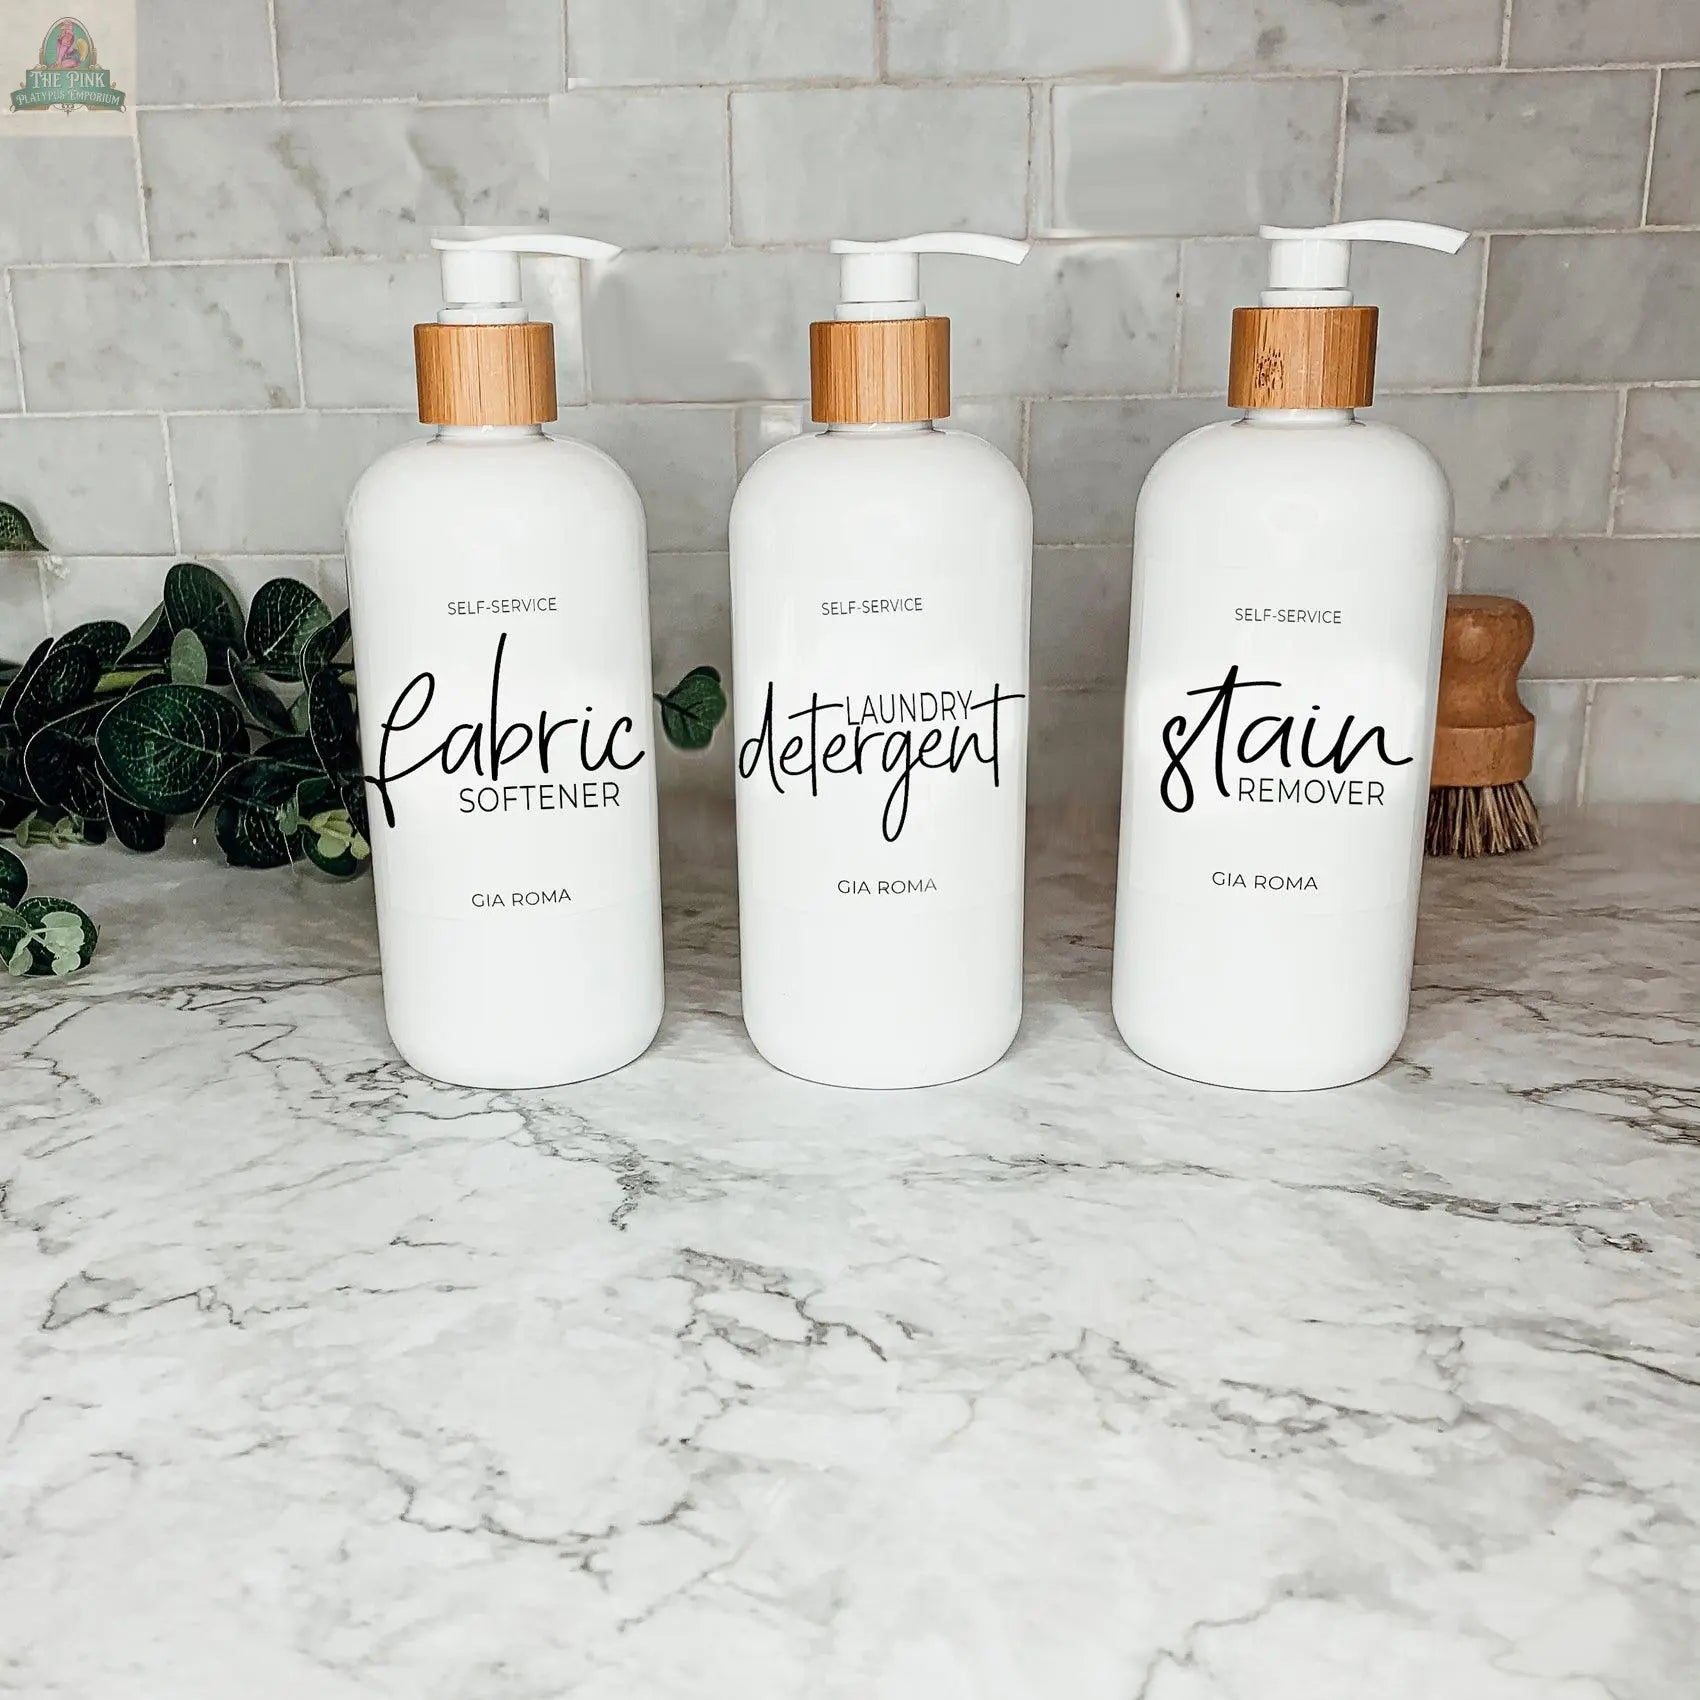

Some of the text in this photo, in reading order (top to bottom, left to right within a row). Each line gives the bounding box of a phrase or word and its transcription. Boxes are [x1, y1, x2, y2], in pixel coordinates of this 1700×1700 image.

[447, 597, 557, 615] SELF-SERVICE
[821, 597, 923, 615] SELF-SERVICE
[1234, 607, 1342, 624] SELF-SERVICE
[846, 690, 973, 725] LAUNDRY
[364, 632, 645, 828] fabric
[1160, 664, 1414, 813] stain
[739, 681, 1026, 842] detergent
[459, 781, 620, 813] SOFTENER
[1238, 777, 1384, 806] REMOVER
[837, 878, 937, 895] GIA ROMA
[1211, 871, 1319, 891] GIA ROMA
[471, 888, 572, 908] GIA ROMA
